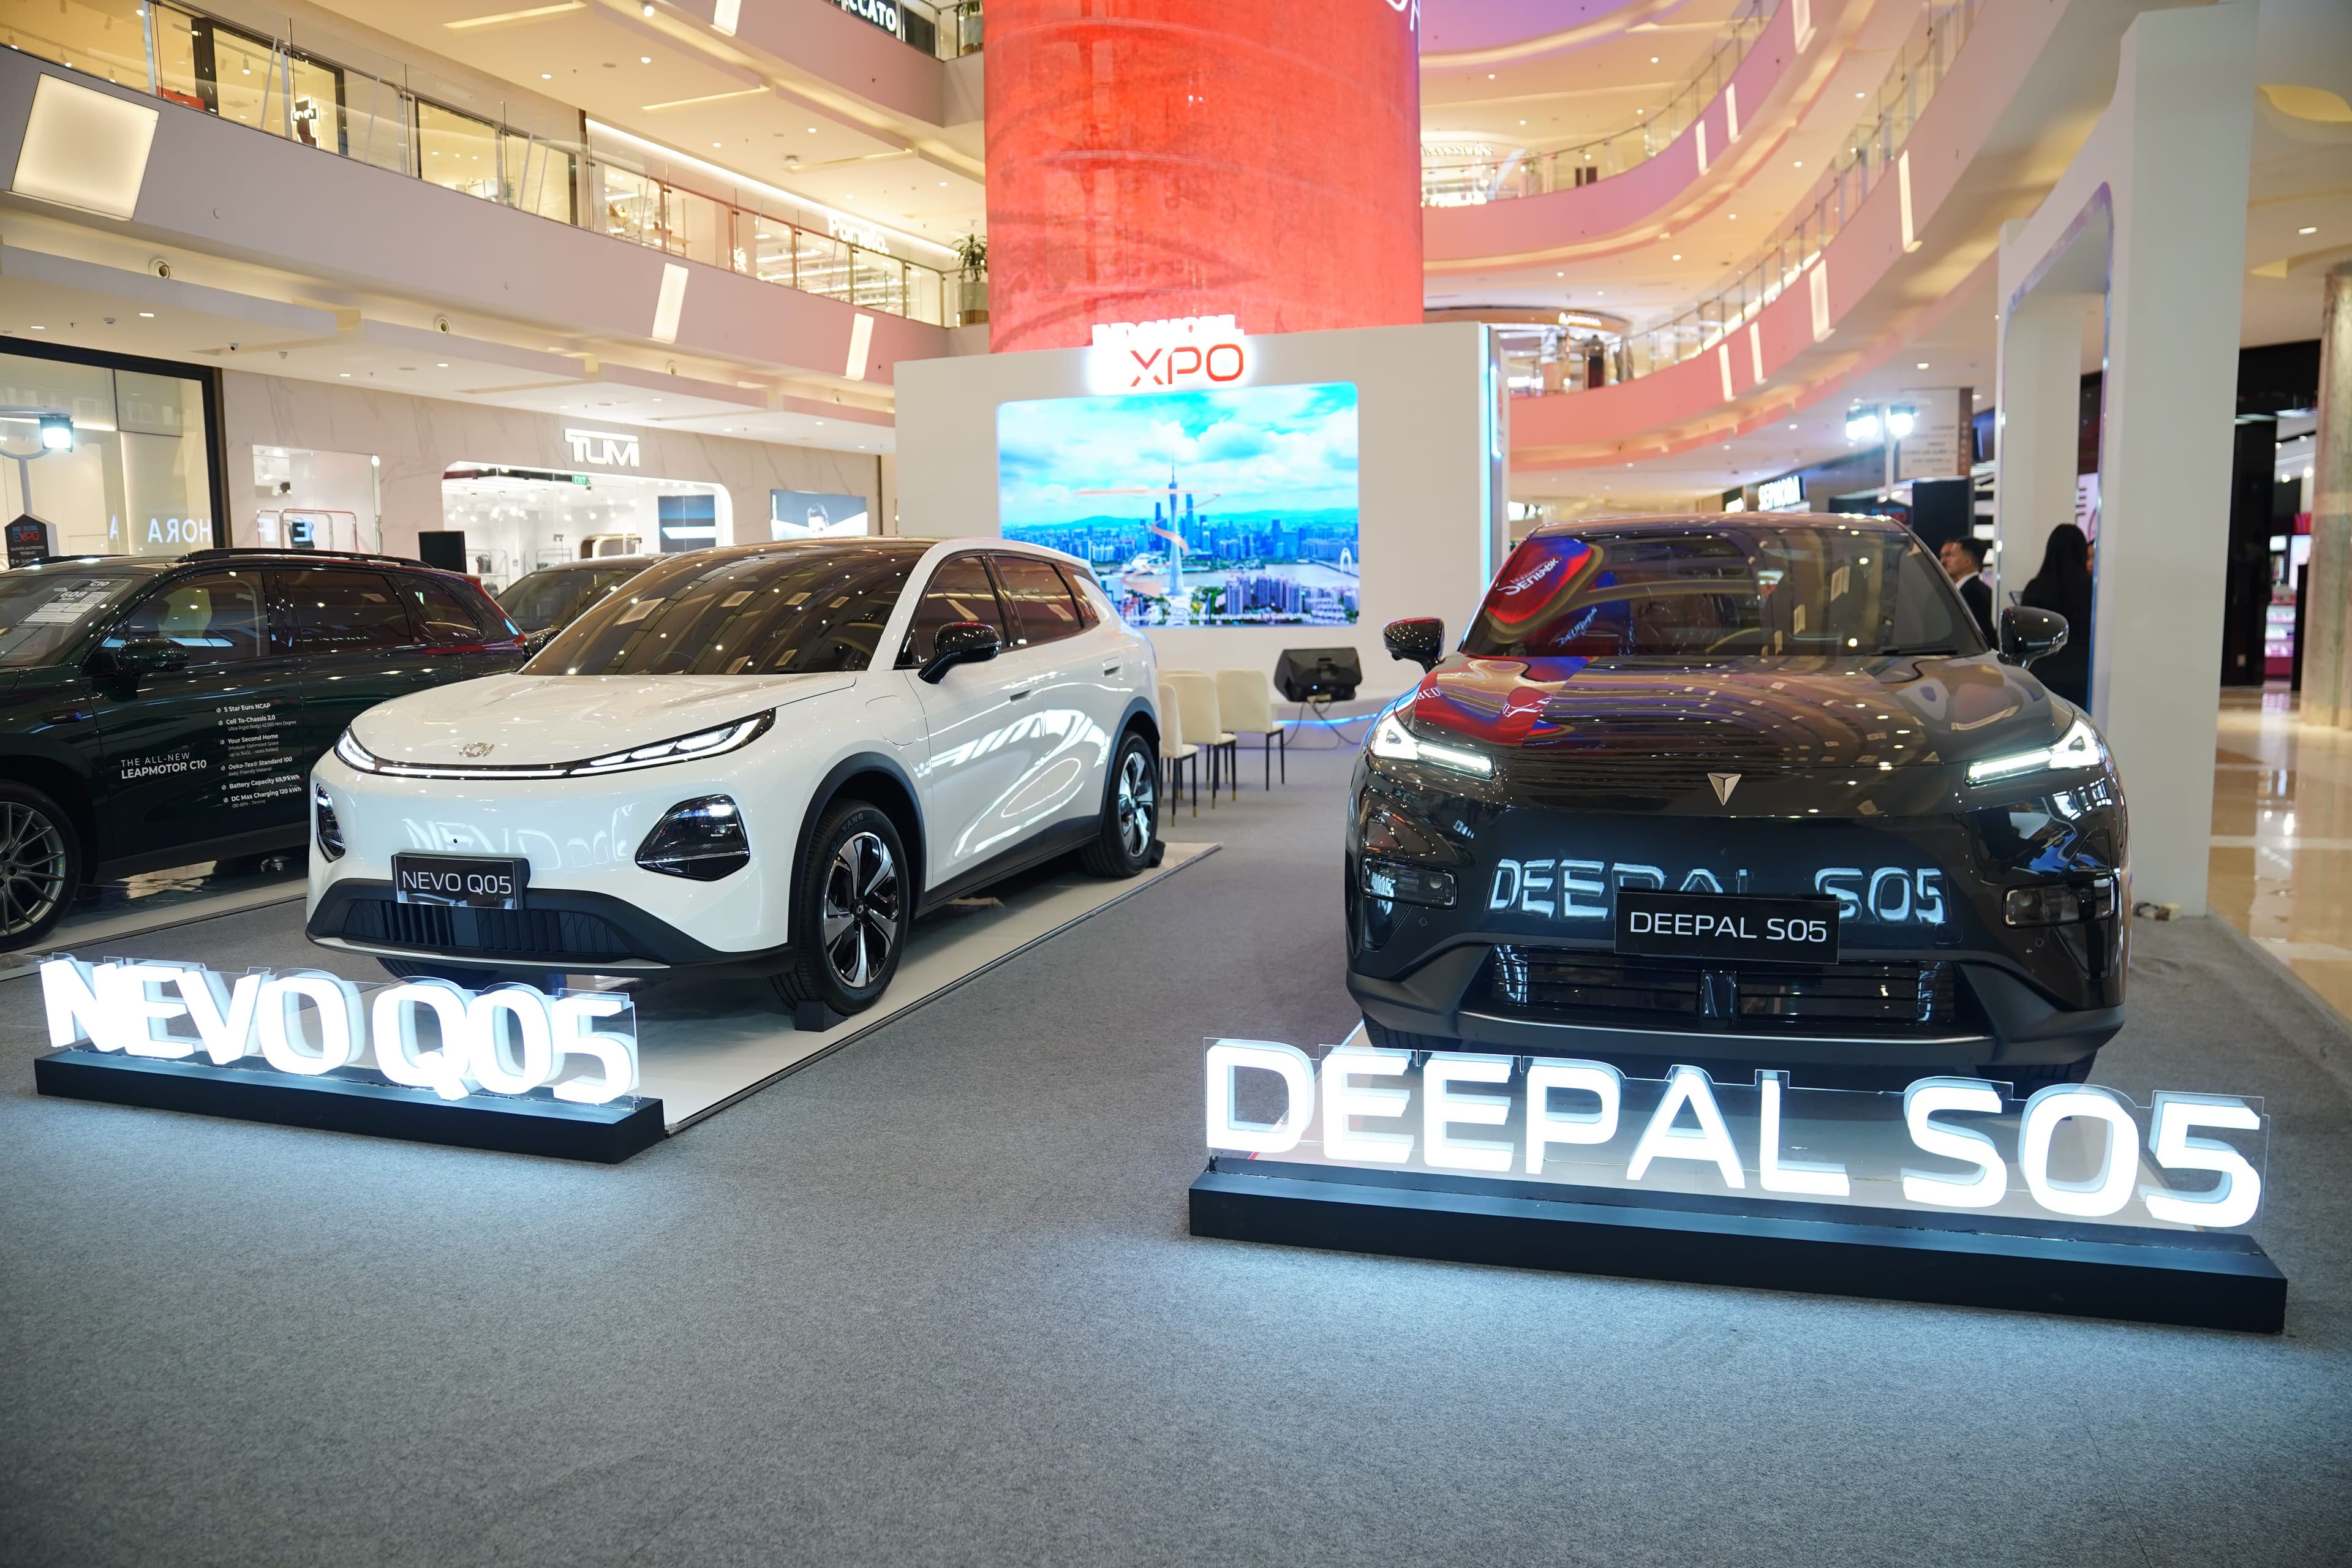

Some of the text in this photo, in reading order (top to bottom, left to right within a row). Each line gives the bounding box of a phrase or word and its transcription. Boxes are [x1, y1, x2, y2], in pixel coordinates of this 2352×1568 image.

[574, 475, 586, 484] EXIT
[121, 752, 190, 767] THE ALL-NEW
[258, 758, 283, 766] Standard
[121, 759, 207, 779] LEAPMOTOR C10
[229, 781, 250, 790] Battery
[251, 778, 274, 786] Capacity
[254, 790, 279, 799] Charging
[402, 870, 512, 895] NEVO Q05
[1629, 911, 1827, 943] DEEPAL S05
[40, 959, 633, 1102] NEVO Q05
[1206, 1039, 2261, 1228] DEEPAL S05
